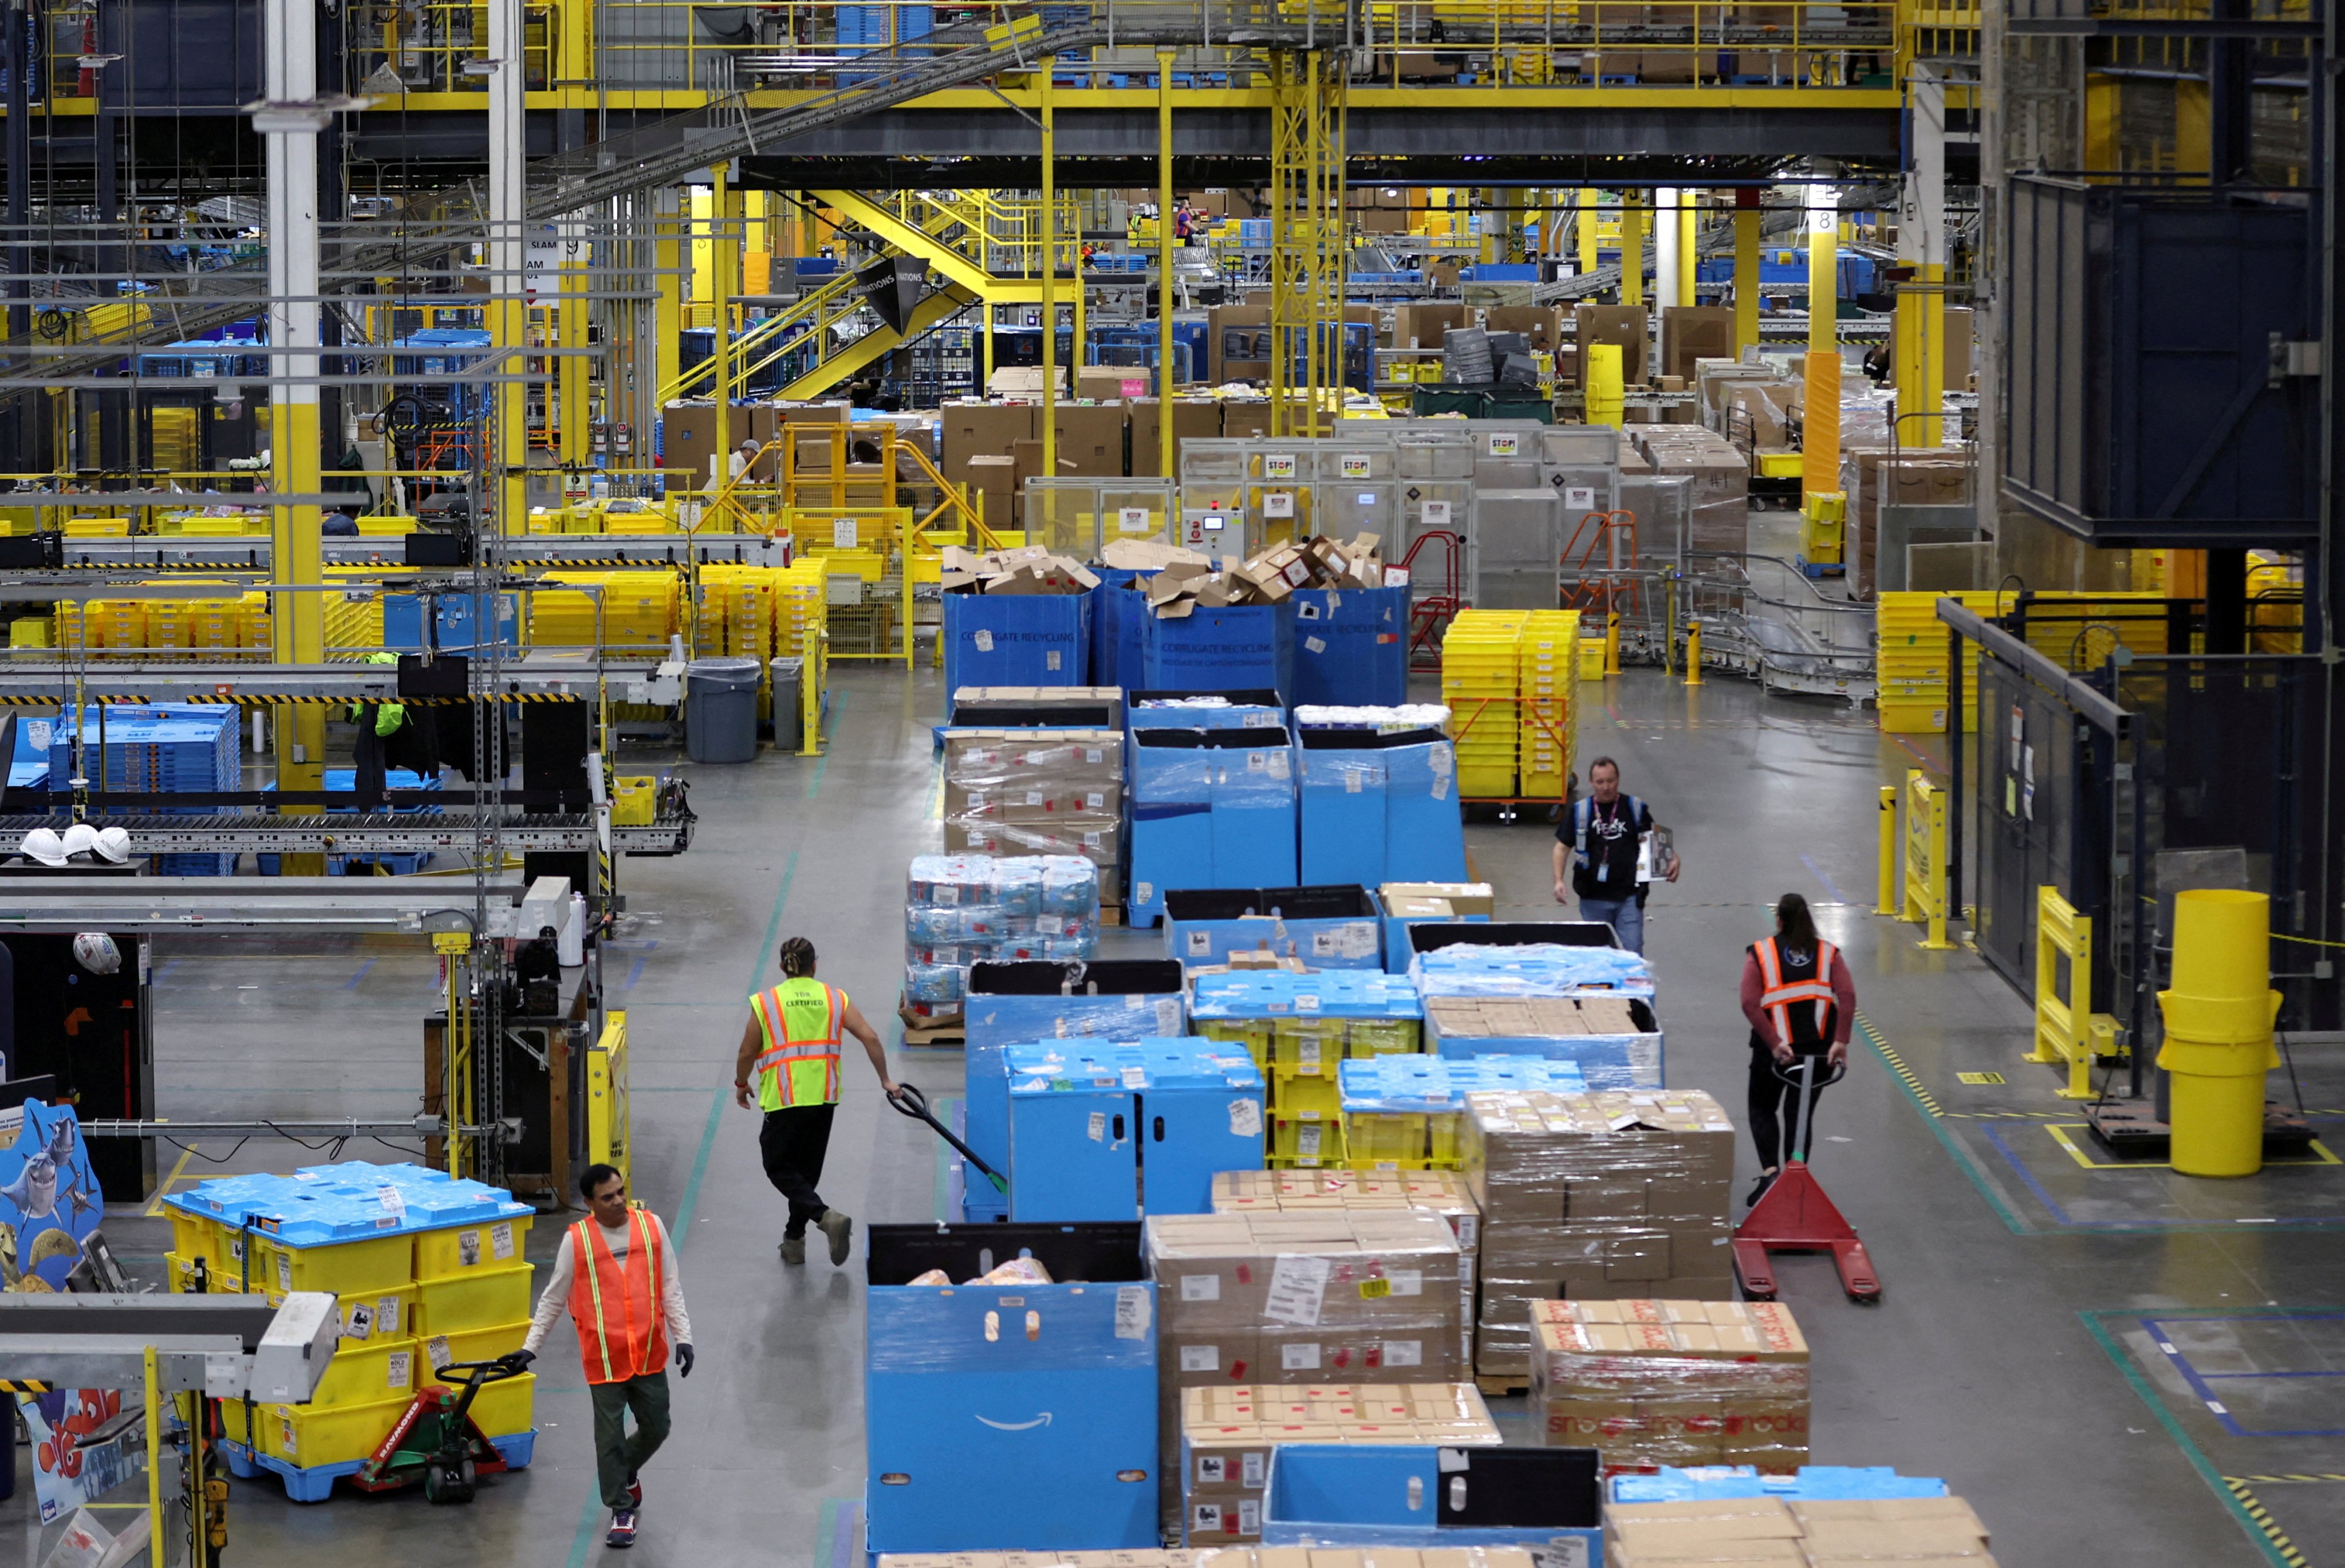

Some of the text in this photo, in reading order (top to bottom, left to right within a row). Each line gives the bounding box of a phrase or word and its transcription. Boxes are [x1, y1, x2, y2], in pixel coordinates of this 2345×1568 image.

[1819, 212, 1830, 228] 8
[526, 261, 543, 269] AM
[961, 632, 1074, 643] COGATE RECYCLING
[1162, 643, 1274, 653] CORRUGATE RECYCLING
[786, 999, 823, 1007] CERTIFIED
[379, 1401, 419, 1458] RAYMOND
